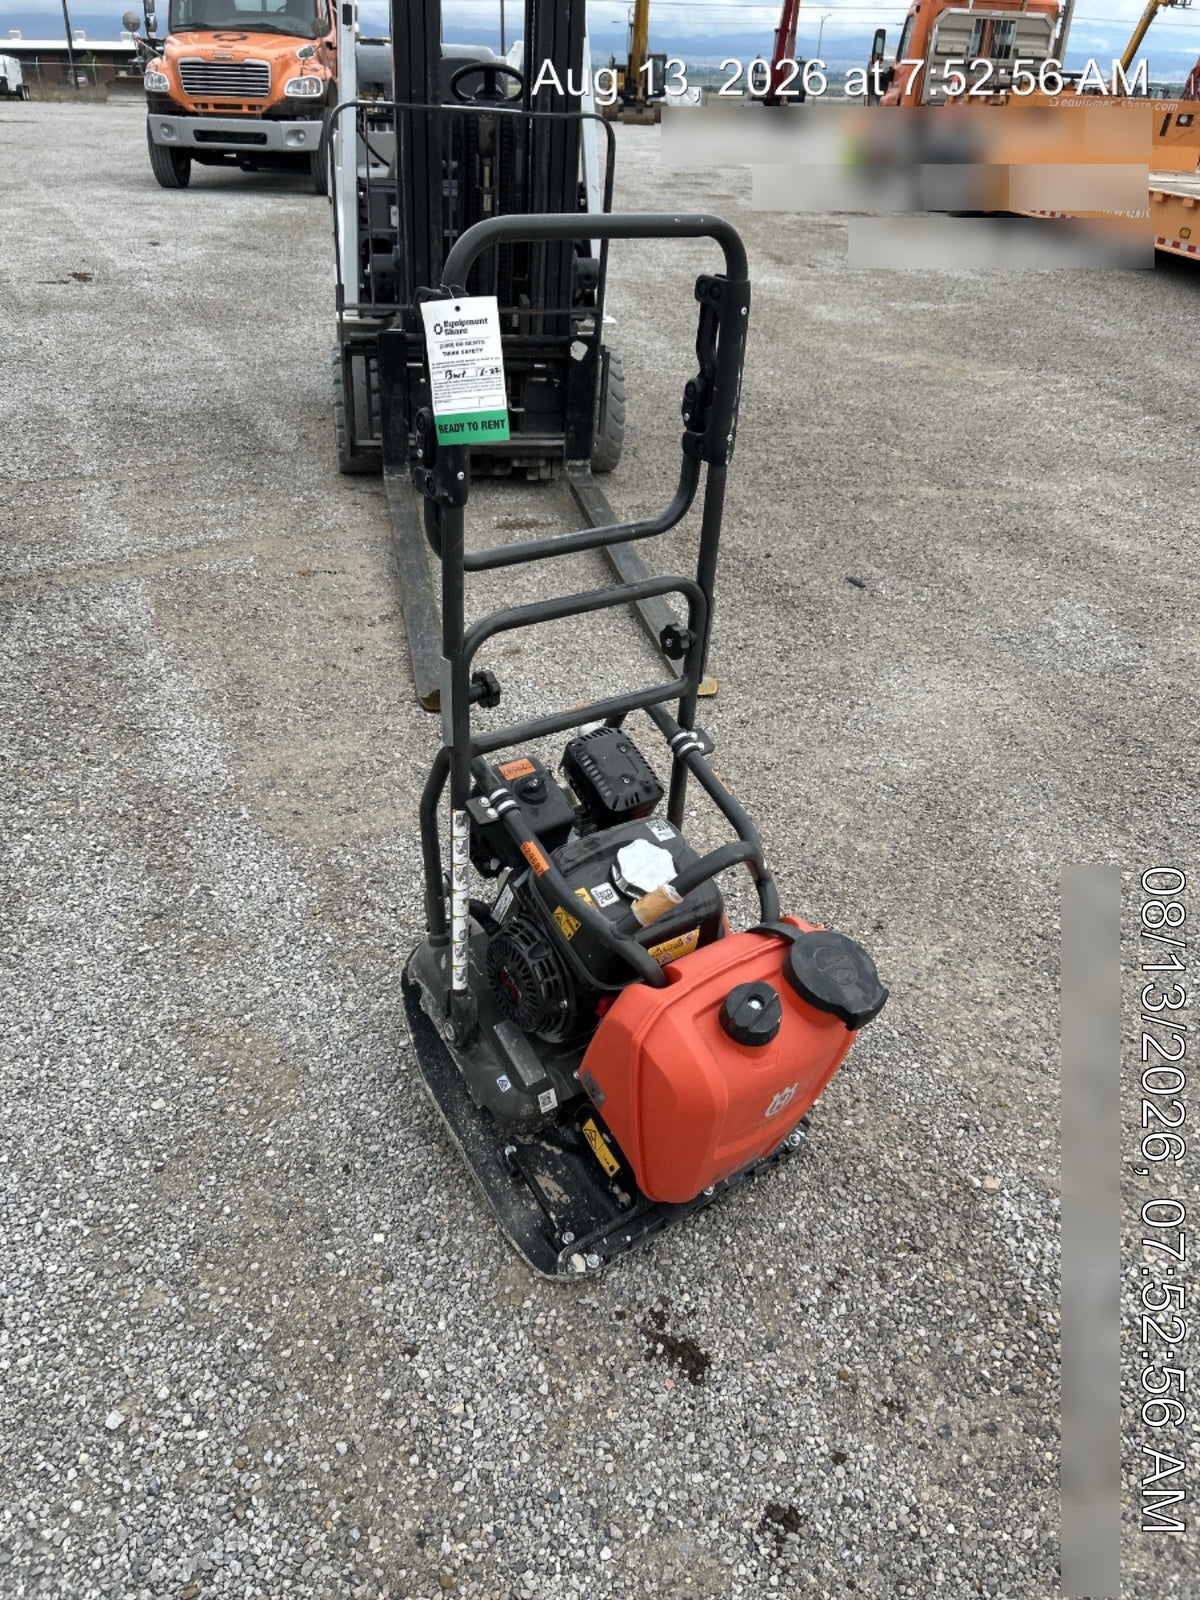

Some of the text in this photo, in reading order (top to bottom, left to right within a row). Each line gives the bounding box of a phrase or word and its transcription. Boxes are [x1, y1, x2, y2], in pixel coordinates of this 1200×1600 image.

[443, 317, 488, 329] Equipment
[444, 328, 468, 336] Share
[438, 419, 506, 434] READY TO RENT
